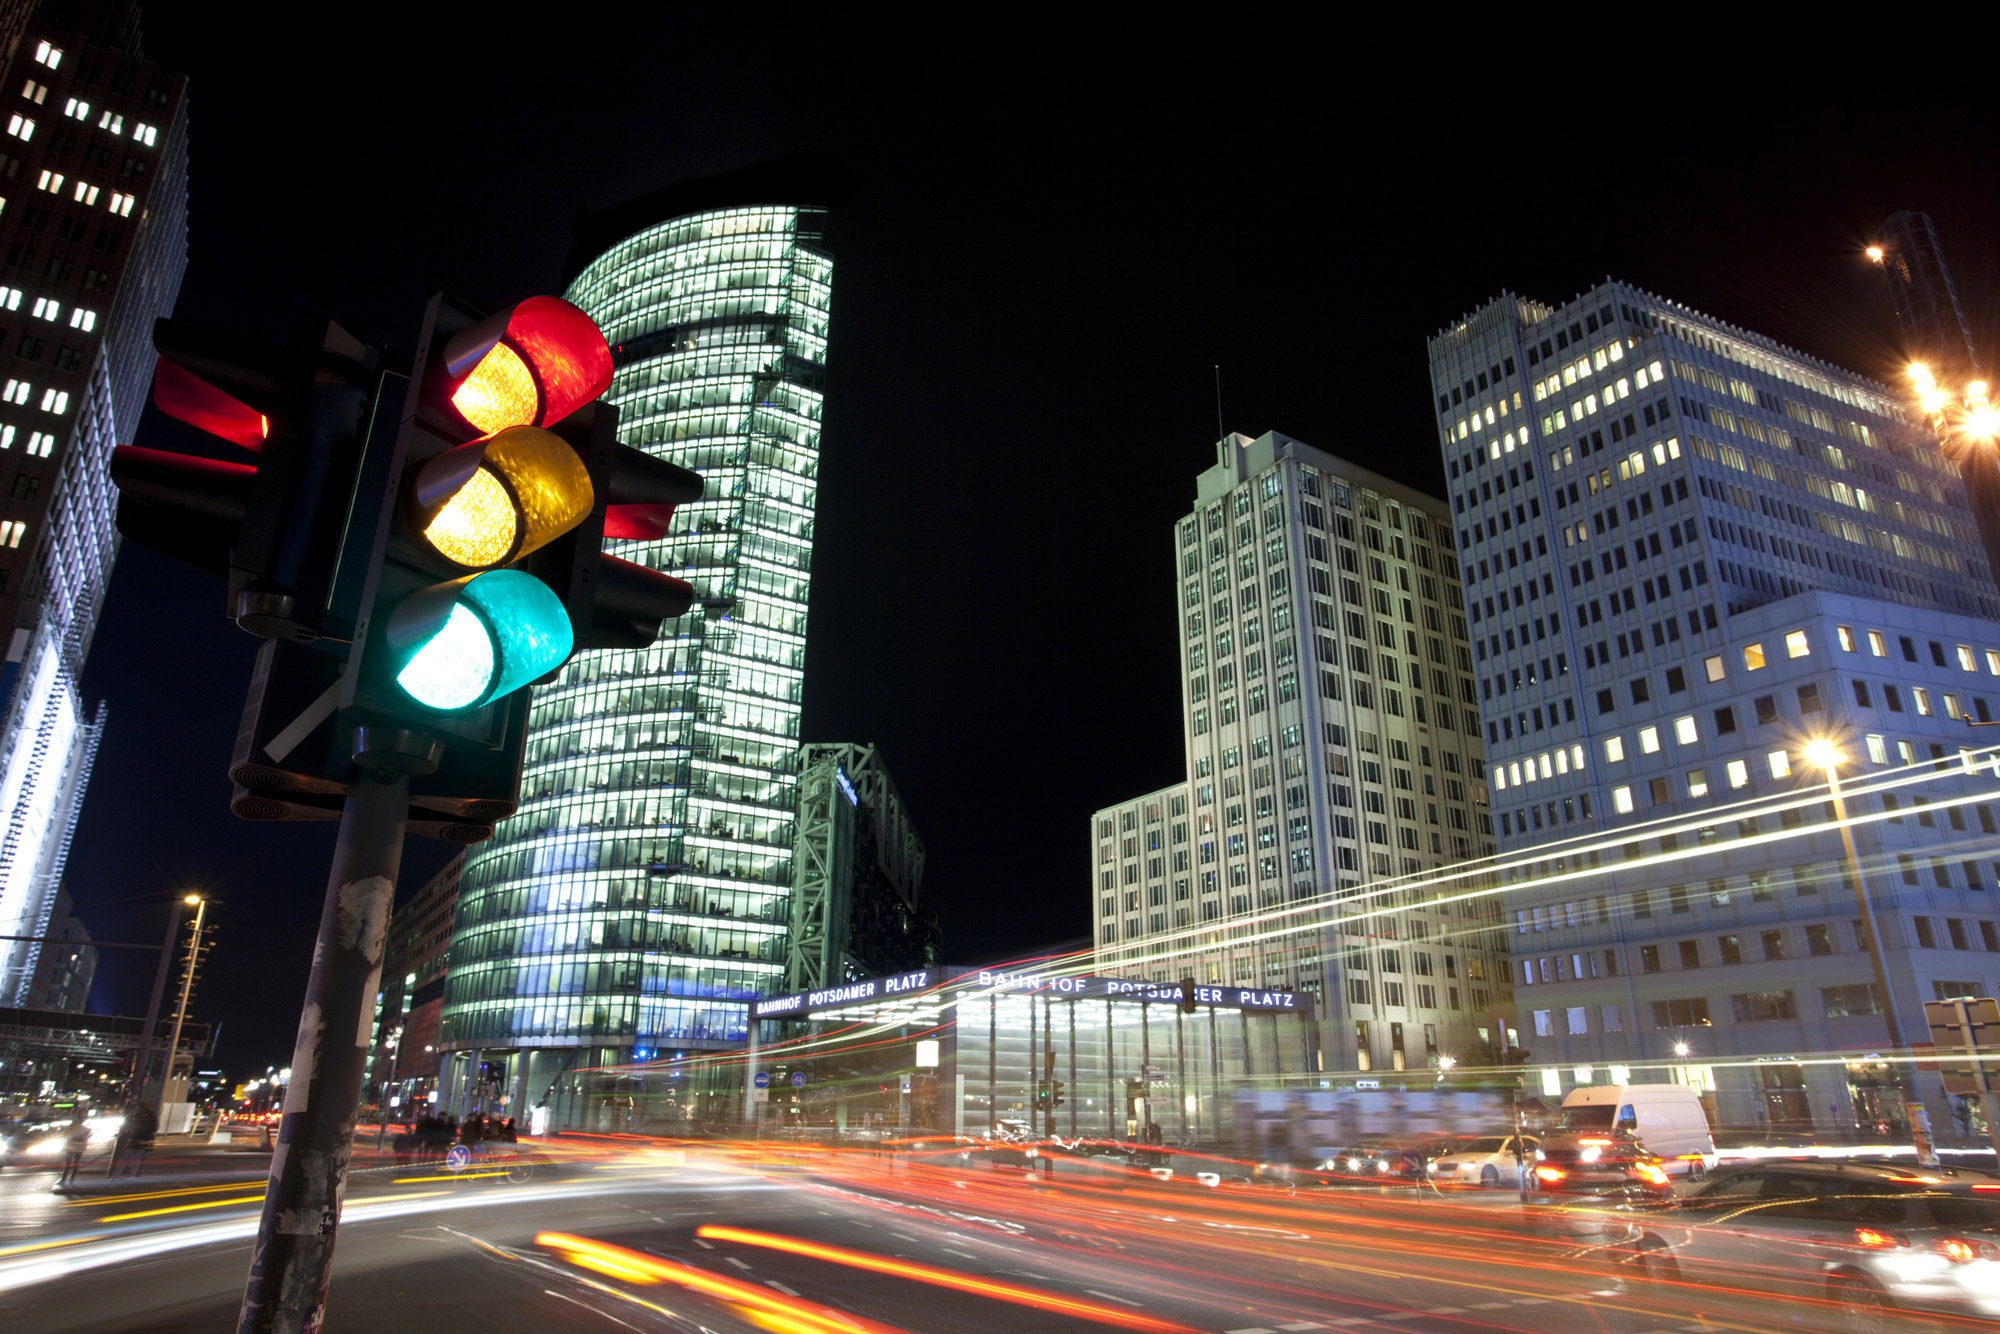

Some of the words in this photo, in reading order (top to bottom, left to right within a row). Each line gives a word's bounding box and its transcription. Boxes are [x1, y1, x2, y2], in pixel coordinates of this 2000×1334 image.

[756, 996, 801, 1014] BAHNHOF
[809, 983, 875, 1006] POTSDAMER
[886, 973, 927, 993] PLATZ
[1107, 981, 1222, 1002] POTSDAER
[1240, 991, 1293, 1007] PLATZ
